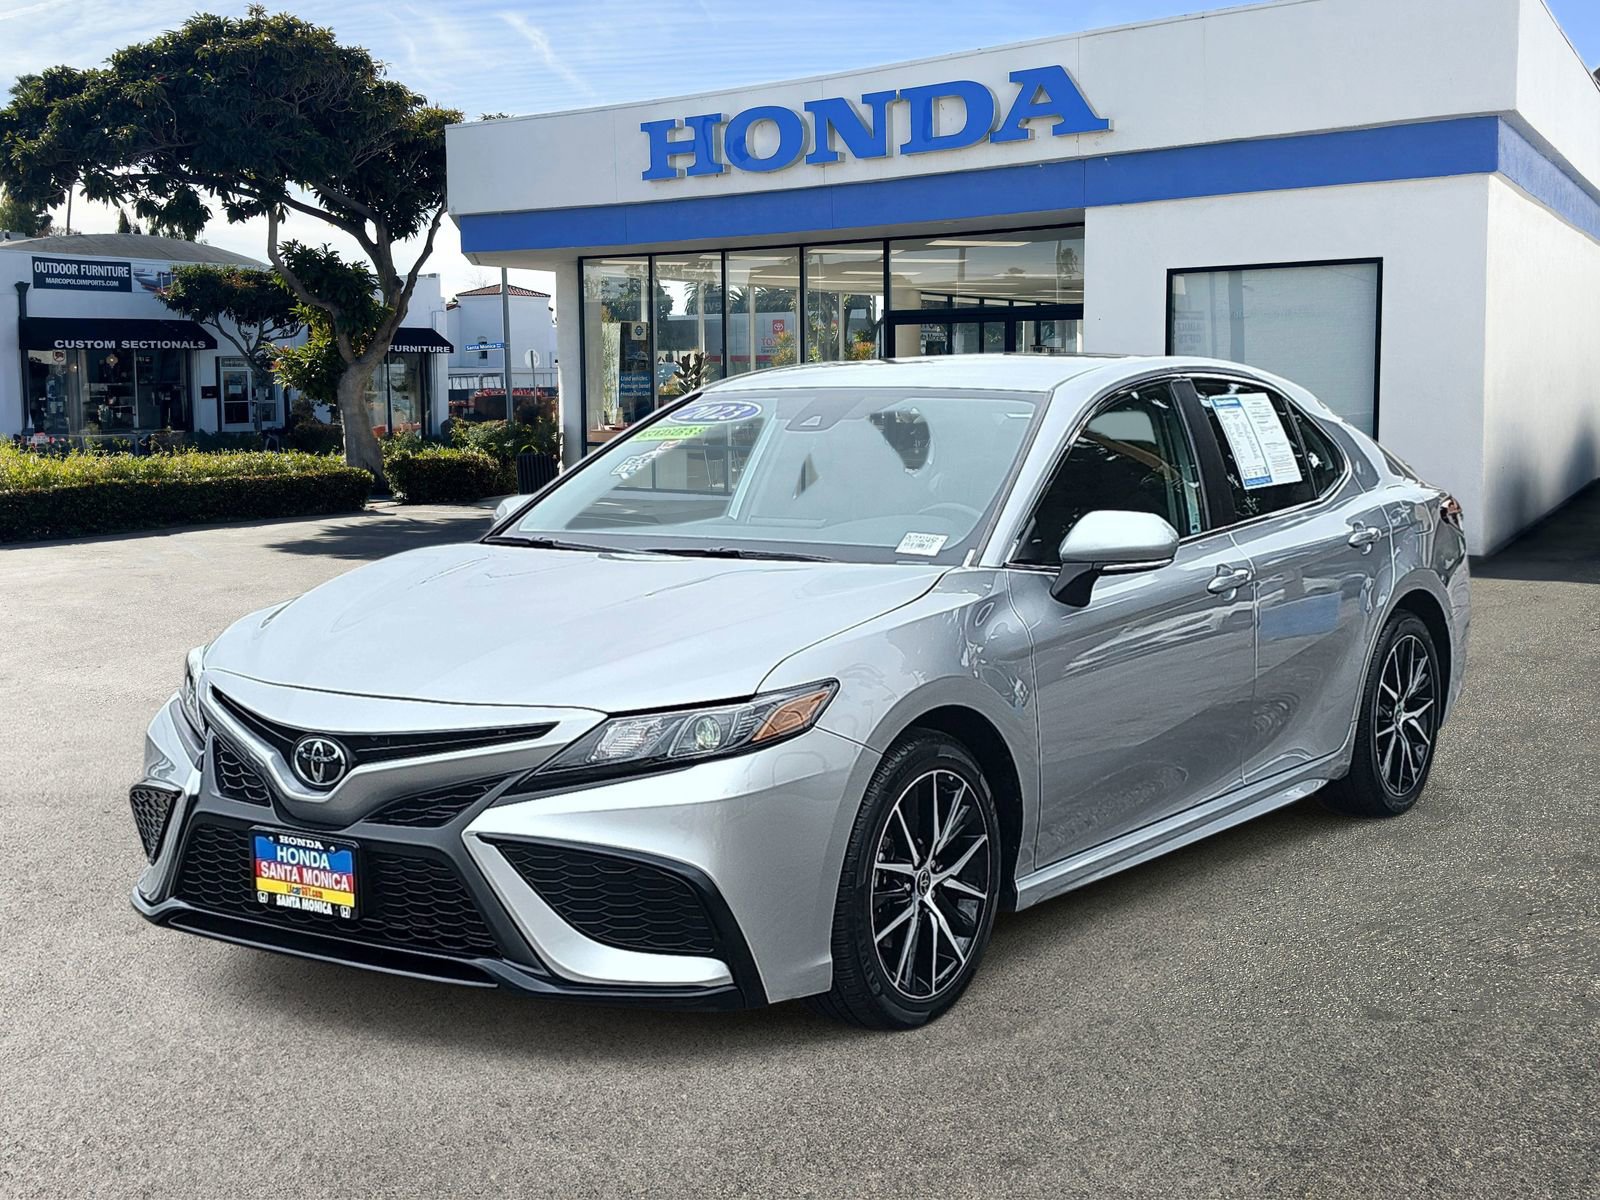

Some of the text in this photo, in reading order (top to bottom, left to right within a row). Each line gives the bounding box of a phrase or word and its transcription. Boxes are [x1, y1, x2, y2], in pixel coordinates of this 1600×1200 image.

[640, 65, 1110, 181] HONDA
[34, 261, 130, 278] OUTDOOR FURNITURE
[45, 277, 119, 287] MARCOPOLOIMPORTS.COM
[54, 339, 206, 349] CUSTOM SECTIONALS
[388, 344, 450, 353] FURNITURE
[676, 405, 752, 420] 2023
[279, 835, 324, 850] HONDA
[276, 846, 331, 870] HONDA
[260, 861, 351, 892] SANTA MONICA
[276, 894, 333, 915] SANTA MONICA
